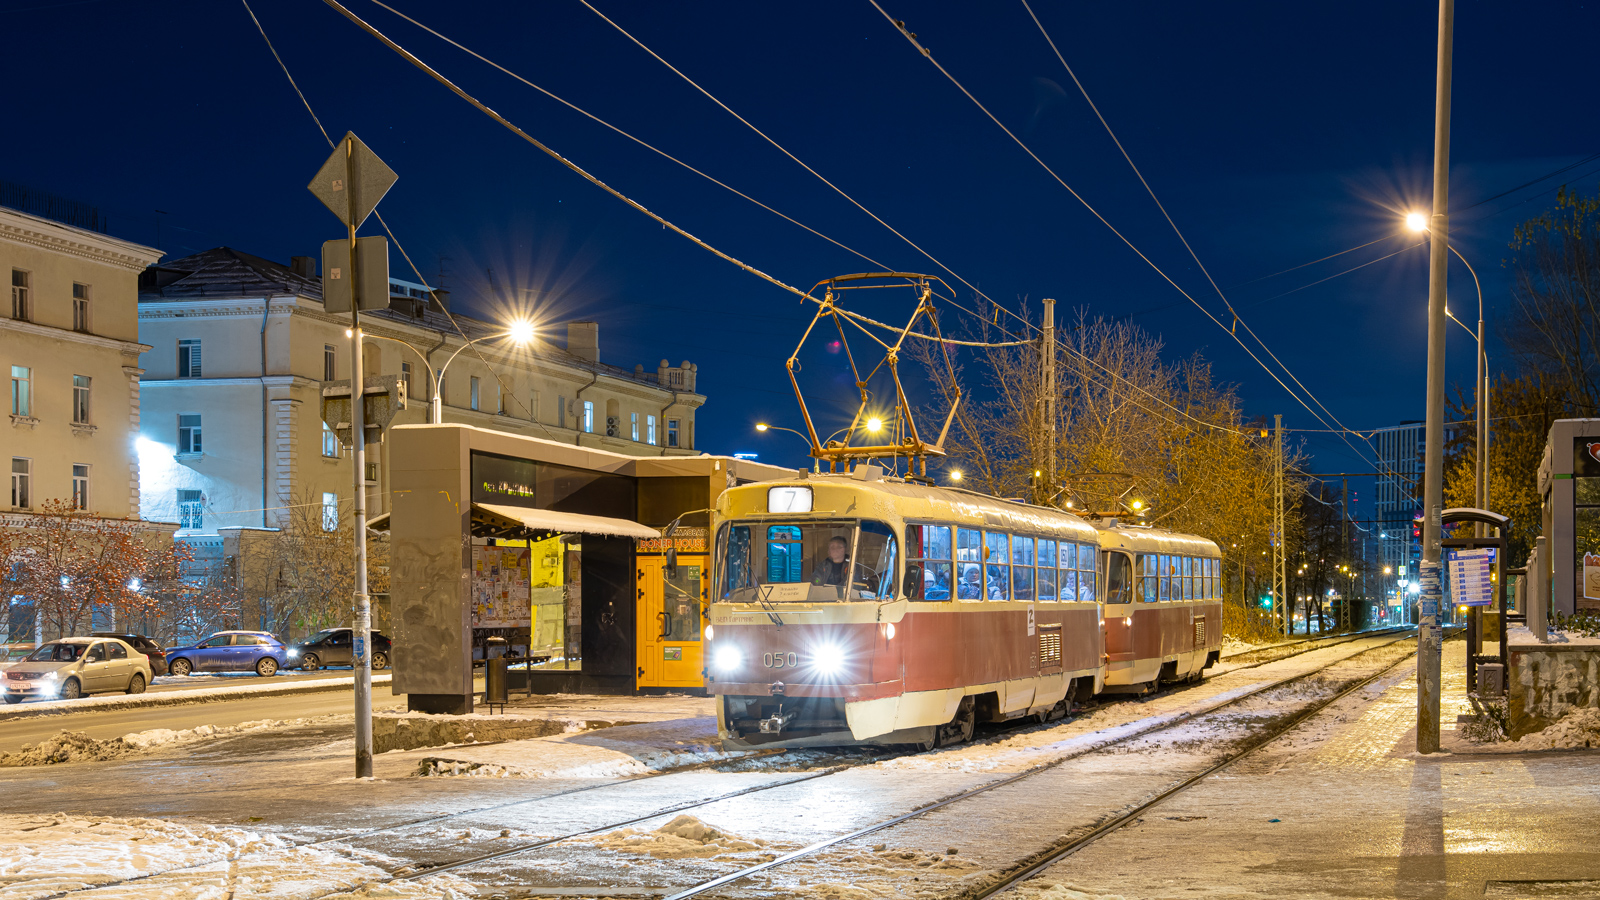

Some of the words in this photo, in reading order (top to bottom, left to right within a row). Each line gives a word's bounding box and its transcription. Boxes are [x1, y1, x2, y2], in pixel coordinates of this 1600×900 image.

[784, 490, 798, 511] 7
[640, 538, 673, 549] DONER
[674, 538, 707, 549] HOUSE
[763, 585, 775, 600] 7
[1028, 608, 1034, 624] 2
[763, 651, 799, 669] 050
